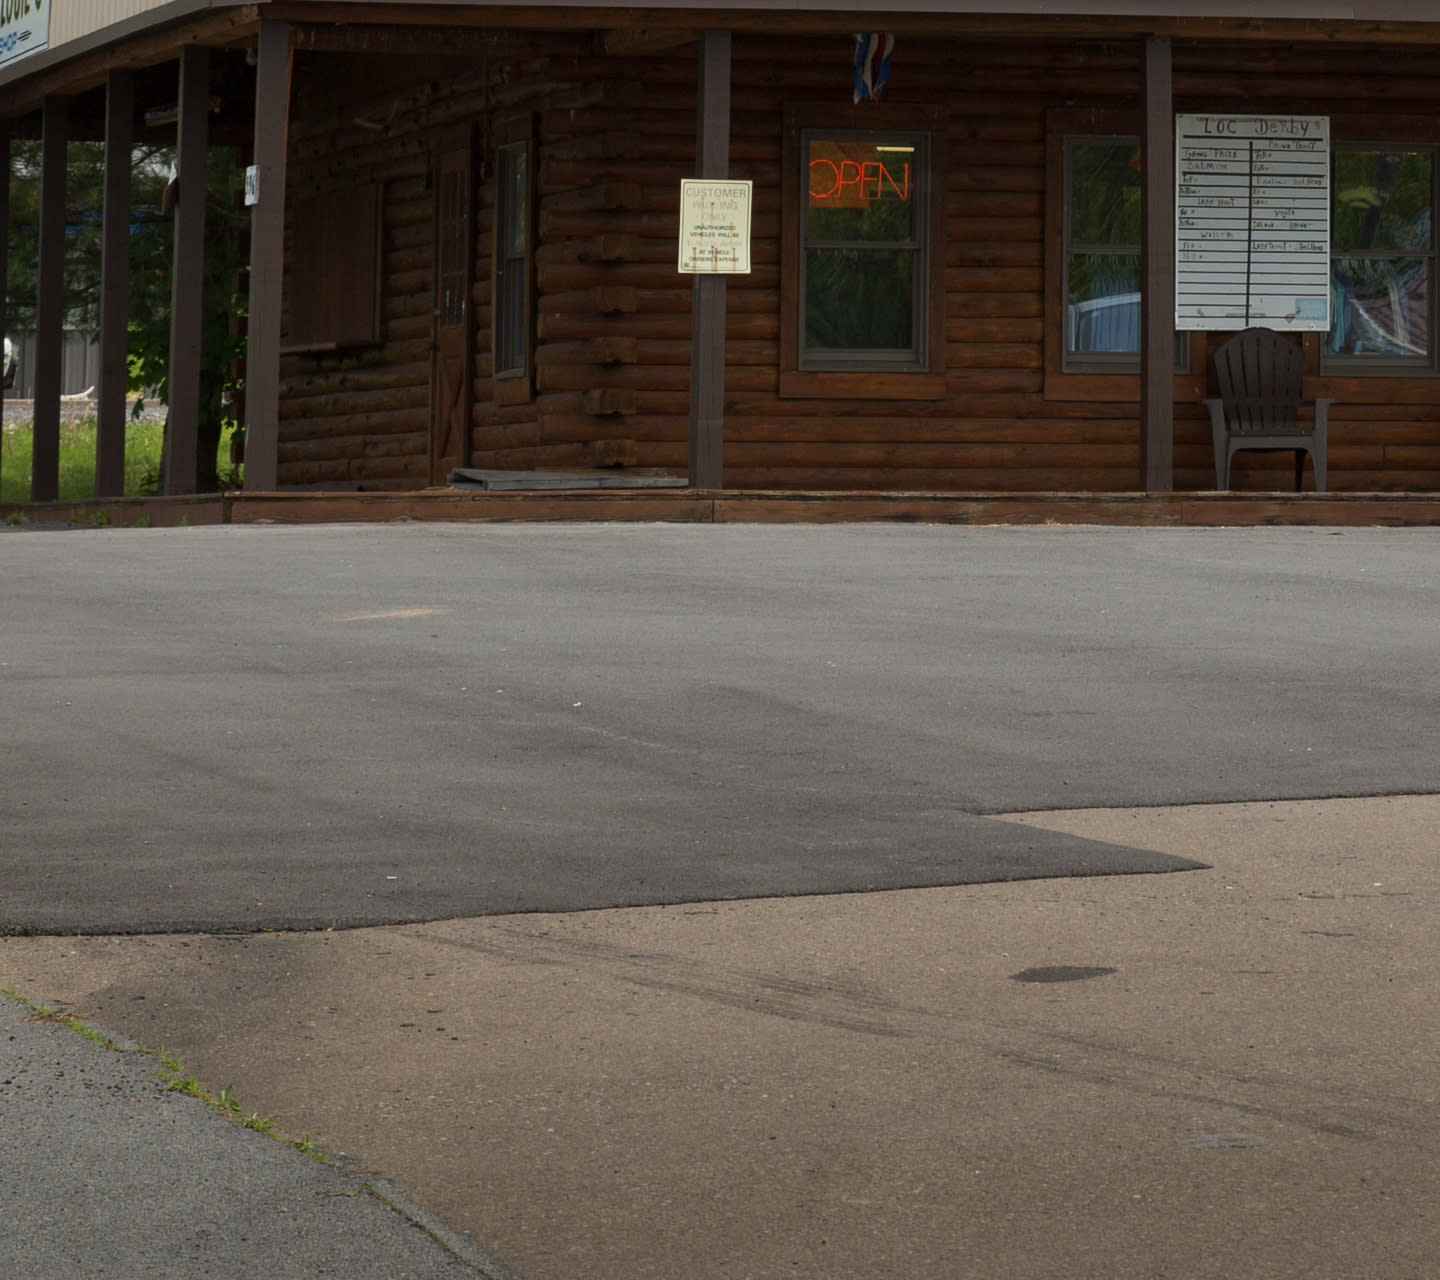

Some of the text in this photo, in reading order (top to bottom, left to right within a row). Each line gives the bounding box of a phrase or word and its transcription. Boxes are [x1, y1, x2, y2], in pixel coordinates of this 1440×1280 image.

[1204, 117, 1237, 134] LOC
[809, 158, 909, 201] OPEN
[686, 187, 747, 199] CUSTOMER
